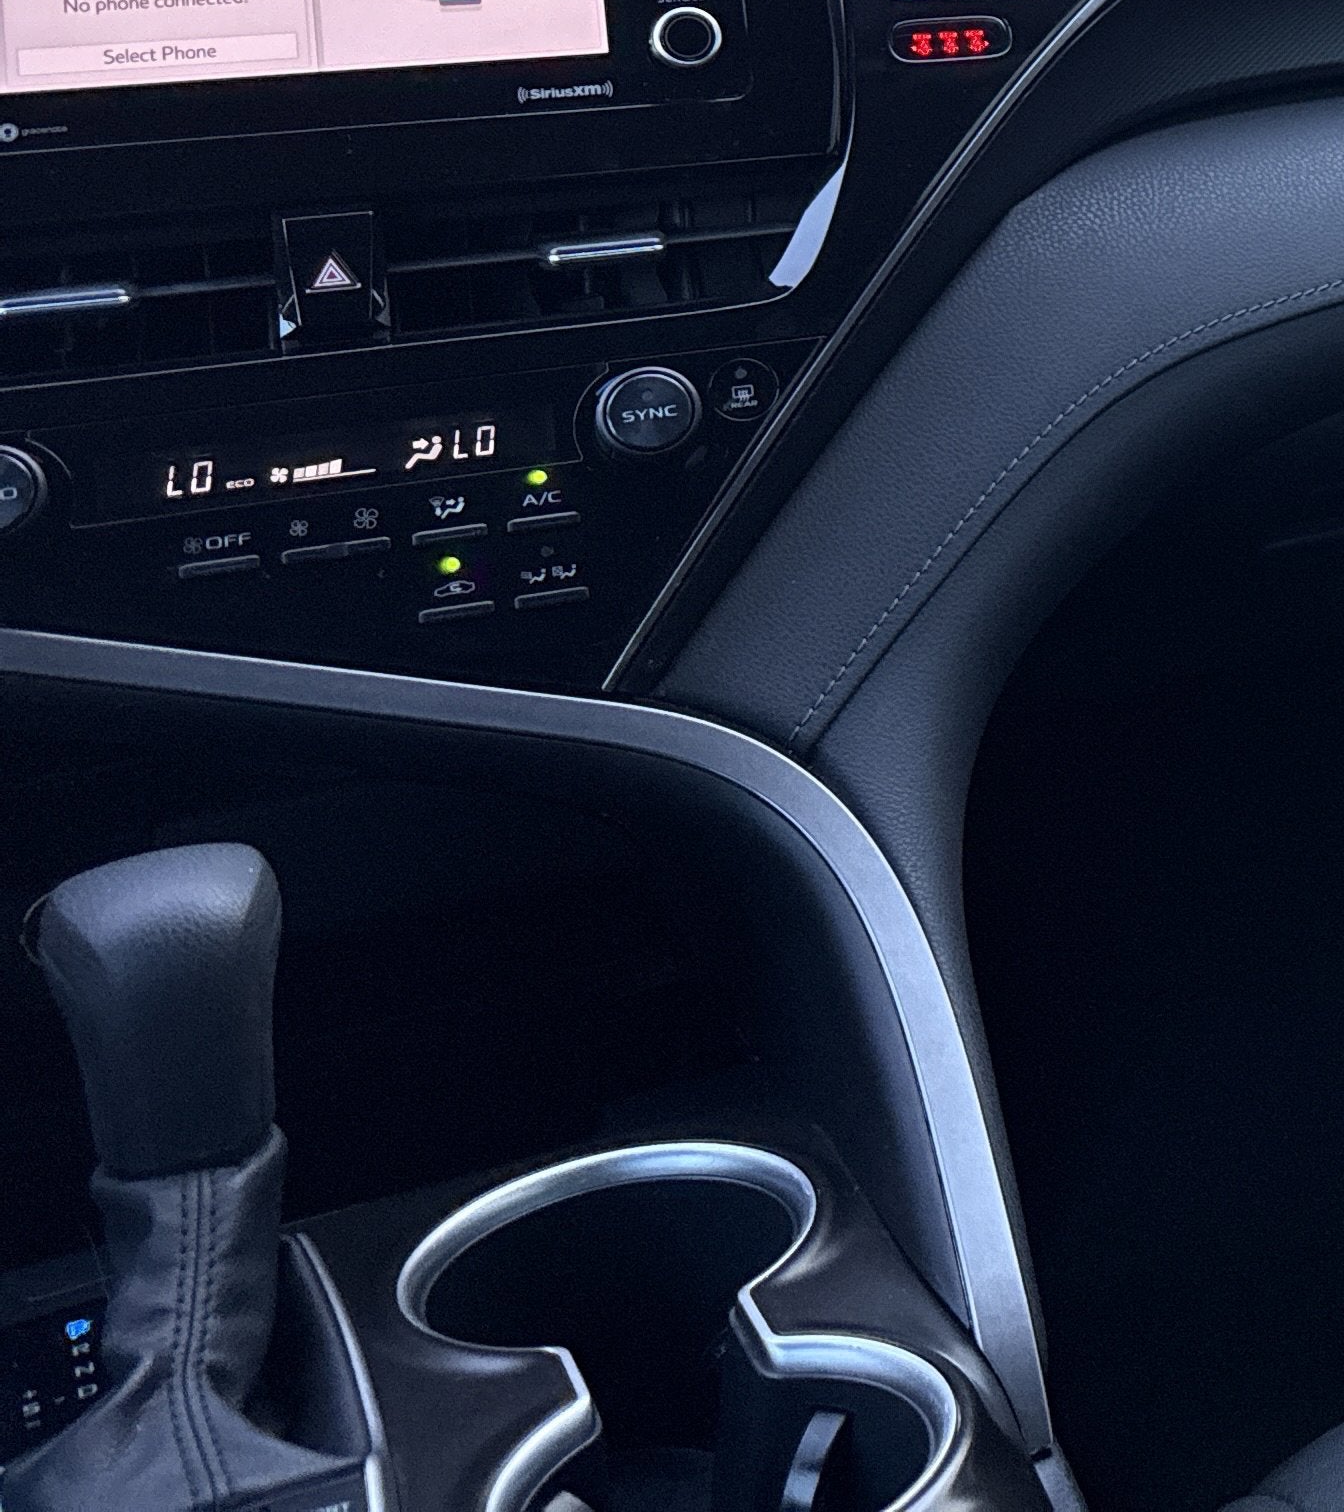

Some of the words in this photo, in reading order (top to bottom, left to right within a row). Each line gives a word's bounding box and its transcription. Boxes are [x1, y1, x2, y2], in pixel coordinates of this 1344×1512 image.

[103, 48, 157, 65] Select
[162, 45, 217, 62] Phone
[622, 404, 678, 424] SYNC
[522, 490, 562, 507] A/C
[205, 532, 251, 550] OFF
